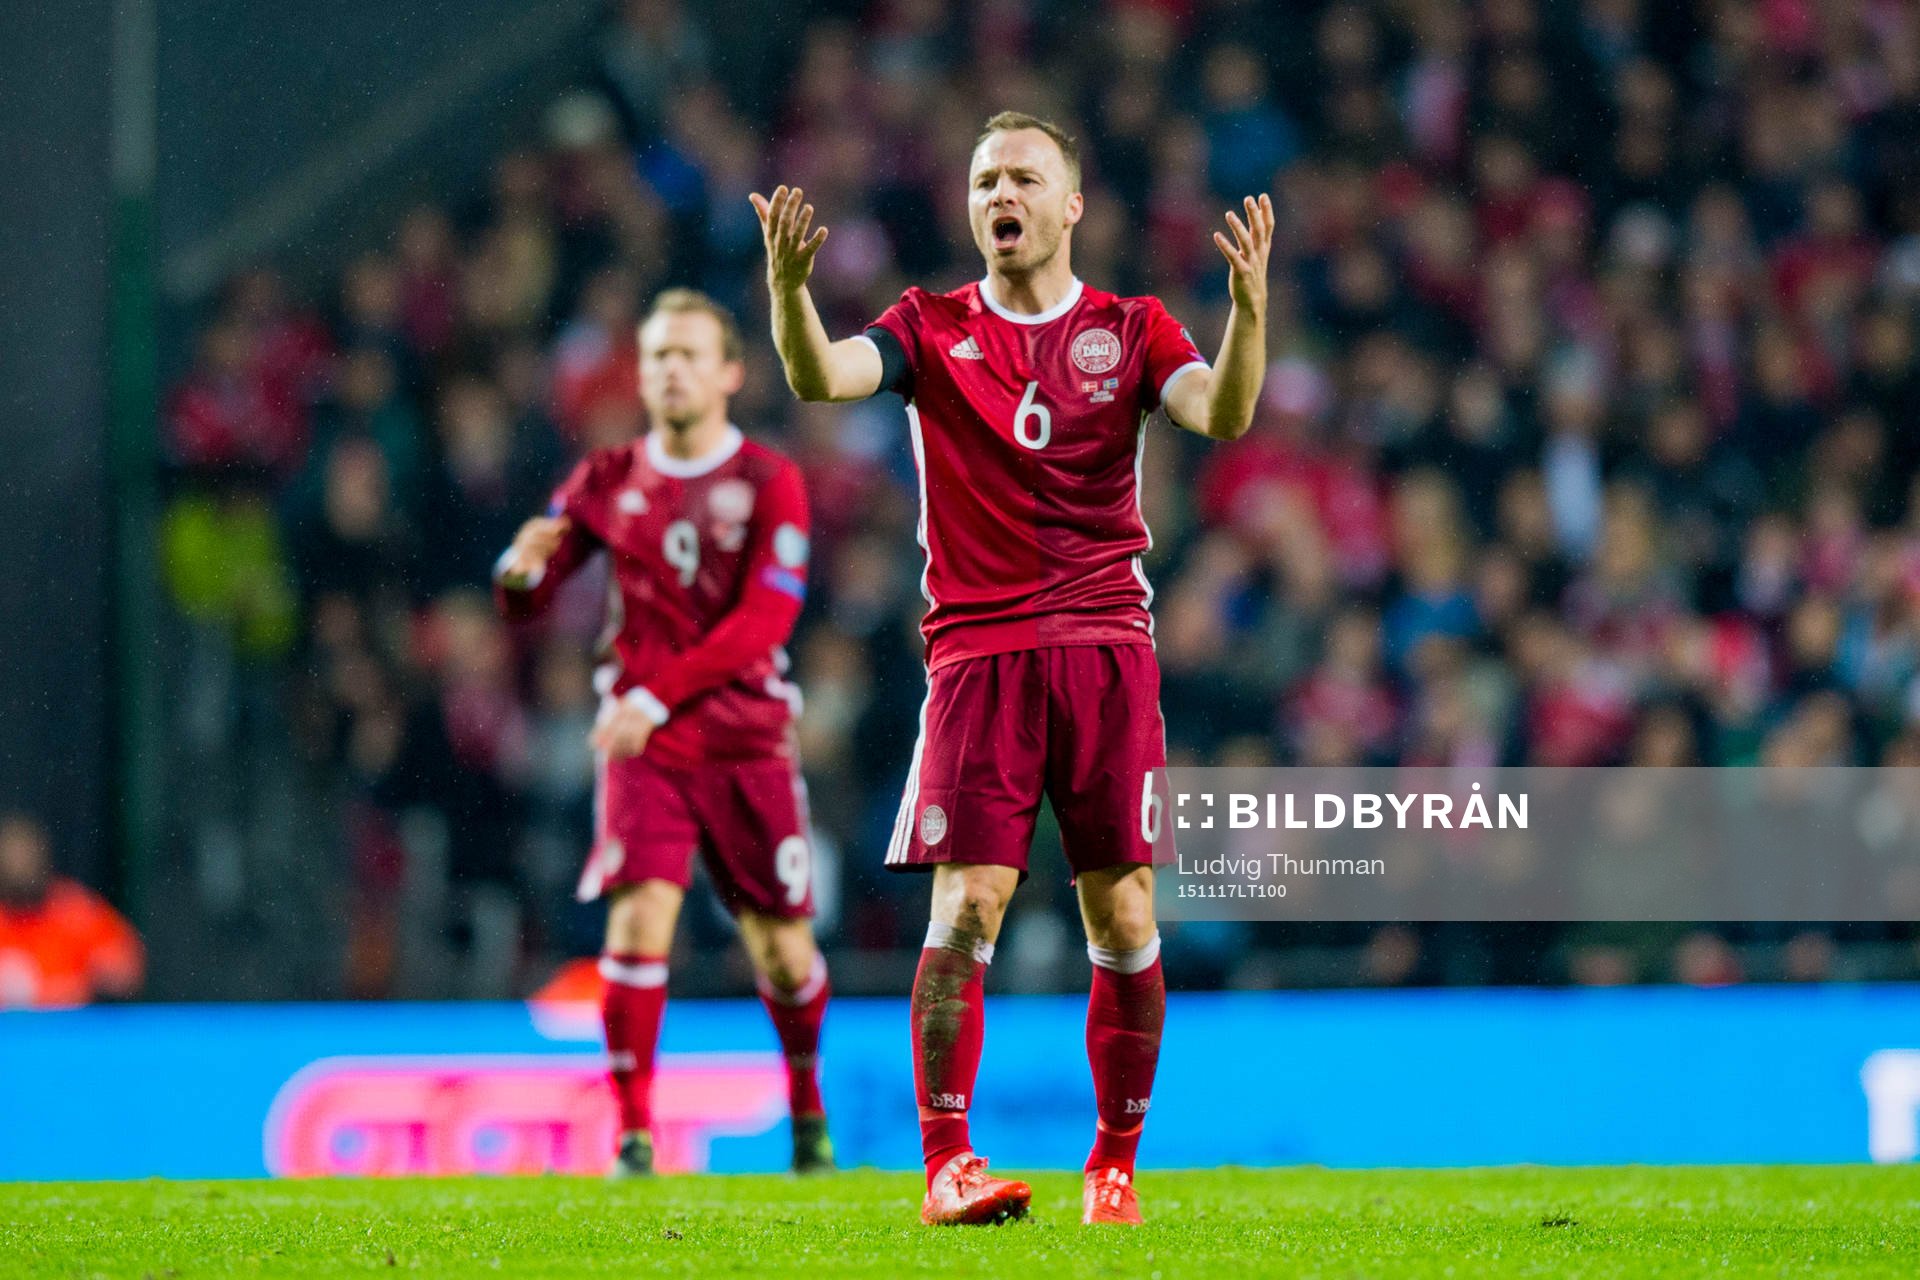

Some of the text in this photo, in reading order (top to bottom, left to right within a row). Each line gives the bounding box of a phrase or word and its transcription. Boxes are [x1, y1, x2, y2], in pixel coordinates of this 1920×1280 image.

[1013, 380, 1051, 450] 6
[663, 520, 700, 588] 9
[1140, 771, 1163, 844] 6
[774, 835, 811, 905] 9
[1124, 1098, 1151, 1113] DB
